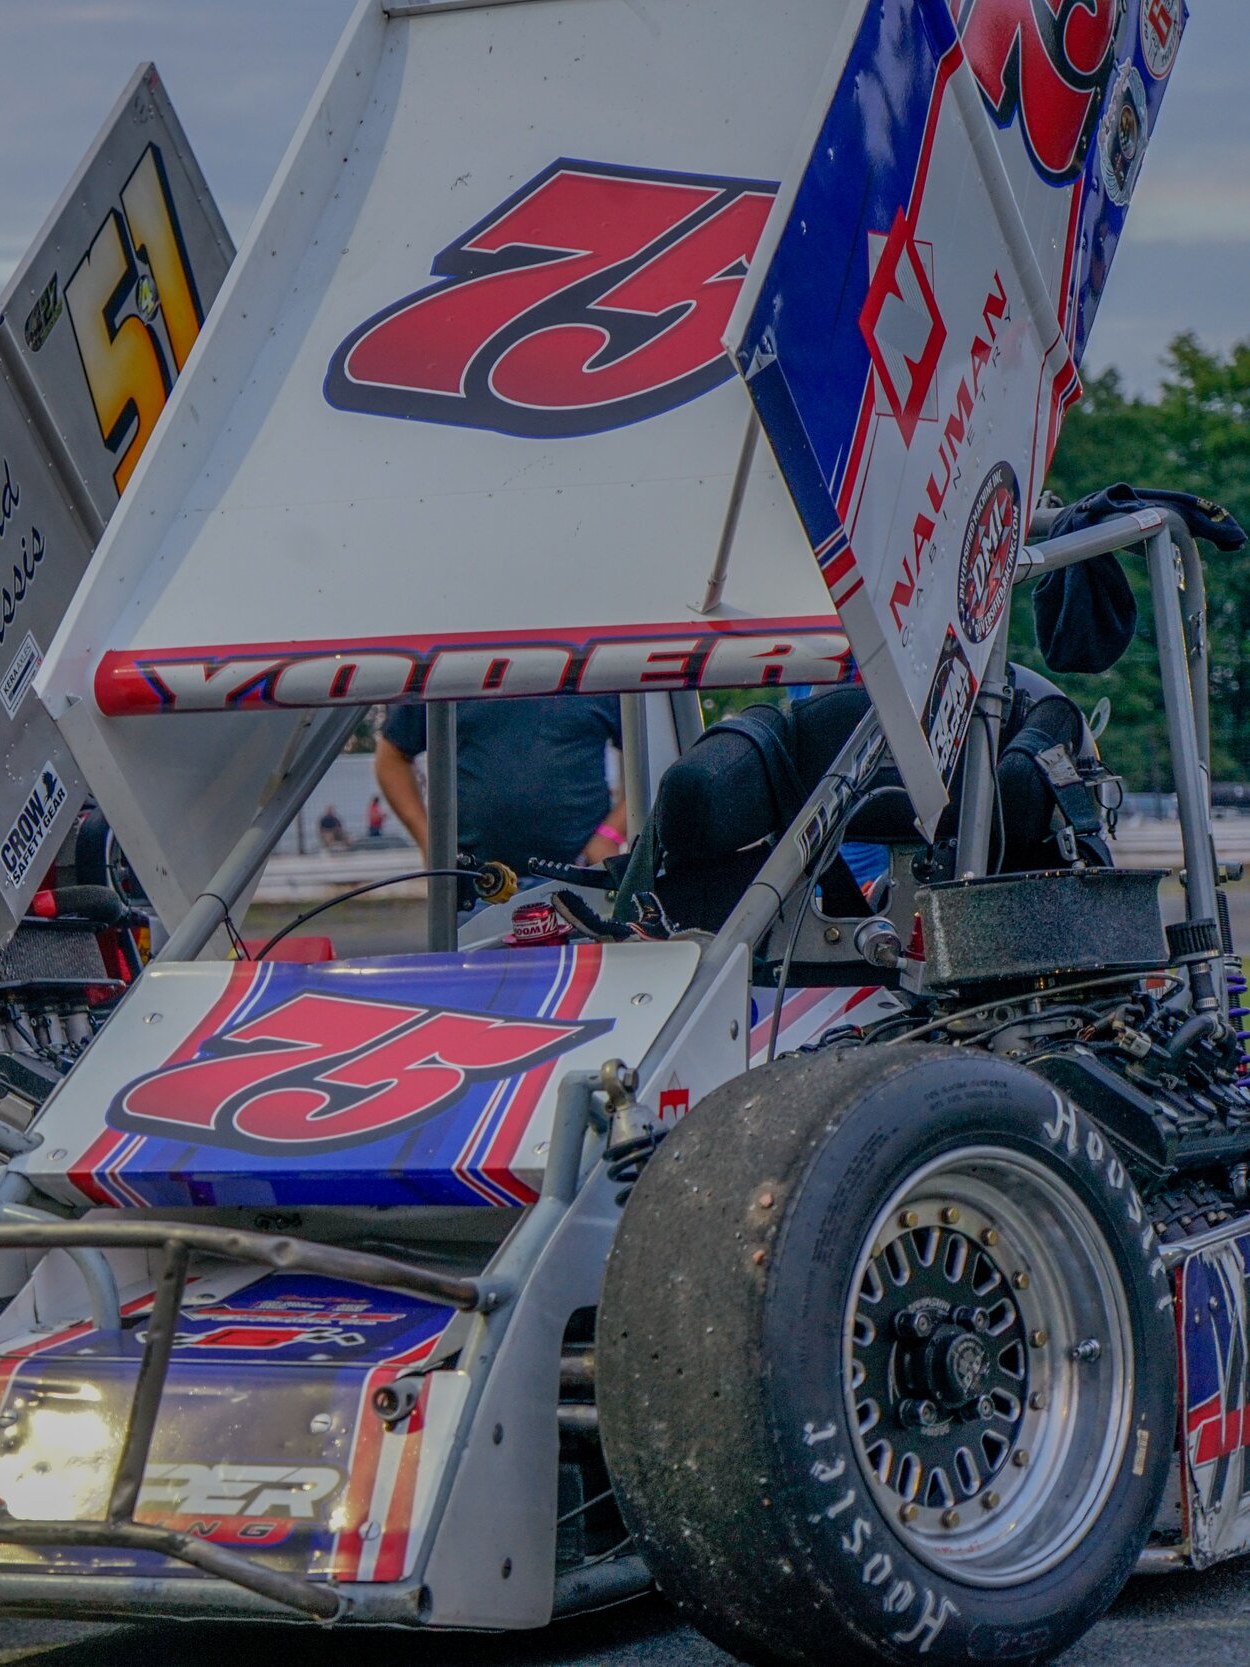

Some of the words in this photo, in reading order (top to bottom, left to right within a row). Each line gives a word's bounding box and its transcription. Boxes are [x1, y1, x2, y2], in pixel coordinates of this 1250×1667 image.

[958, 0, 1118, 183] 7
[326, 159, 780, 436] 75
[889, 269, 1008, 633] NAUMAN
[901, 304, 1012, 648] CABINETRY
[971, 498, 1003, 601] DMI
[142, 630, 854, 710] YODER
[0, 789, 46, 873] CROW
[12, 825, 44, 885] SAFETY
[42, 787, 67, 828] GEAR
[107, 990, 610, 1154] 75
[803, 1422, 962, 1654] Hoosier
